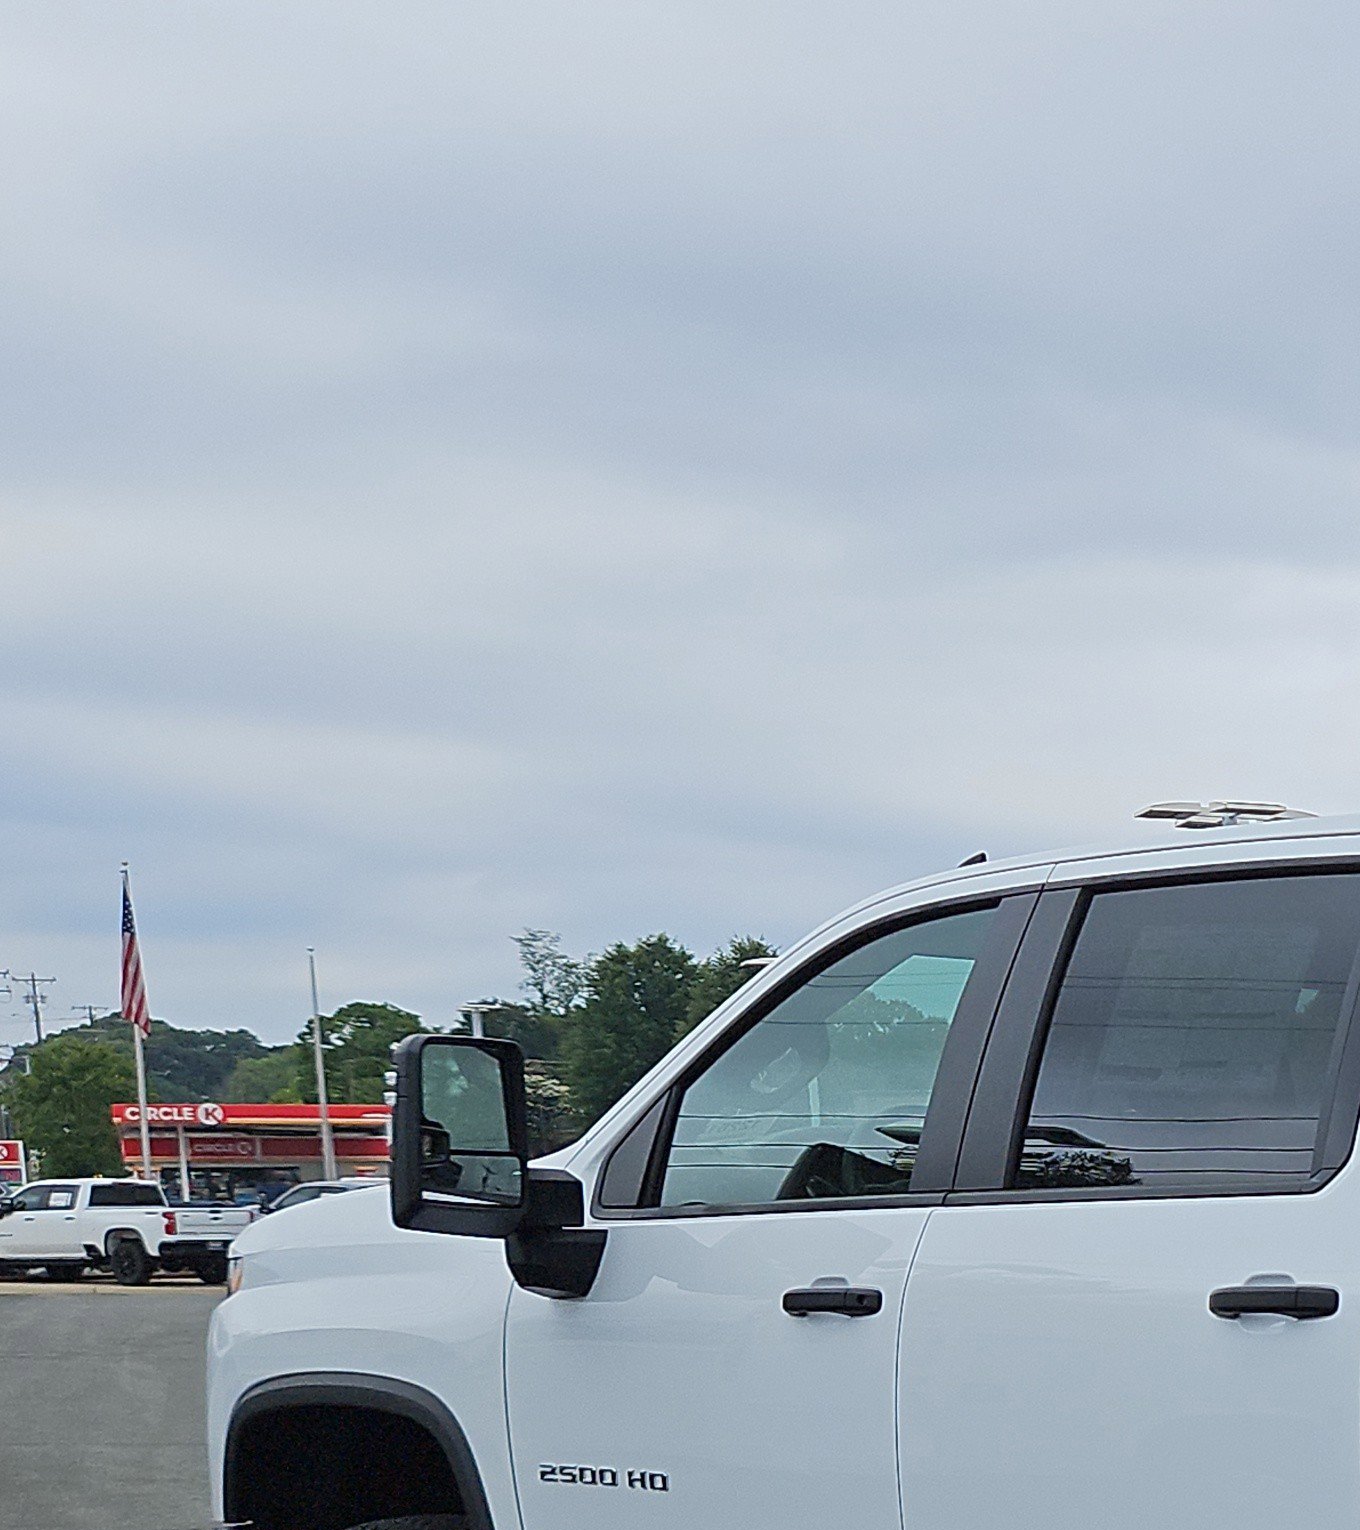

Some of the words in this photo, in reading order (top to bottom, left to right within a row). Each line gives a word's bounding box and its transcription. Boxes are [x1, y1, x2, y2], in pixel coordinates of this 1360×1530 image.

[124, 1106, 195, 1121] CRCLE
[203, 1105, 221, 1124] K
[539, 1463, 619, 1487] 2500
[626, 1469, 670, 1492] HD
